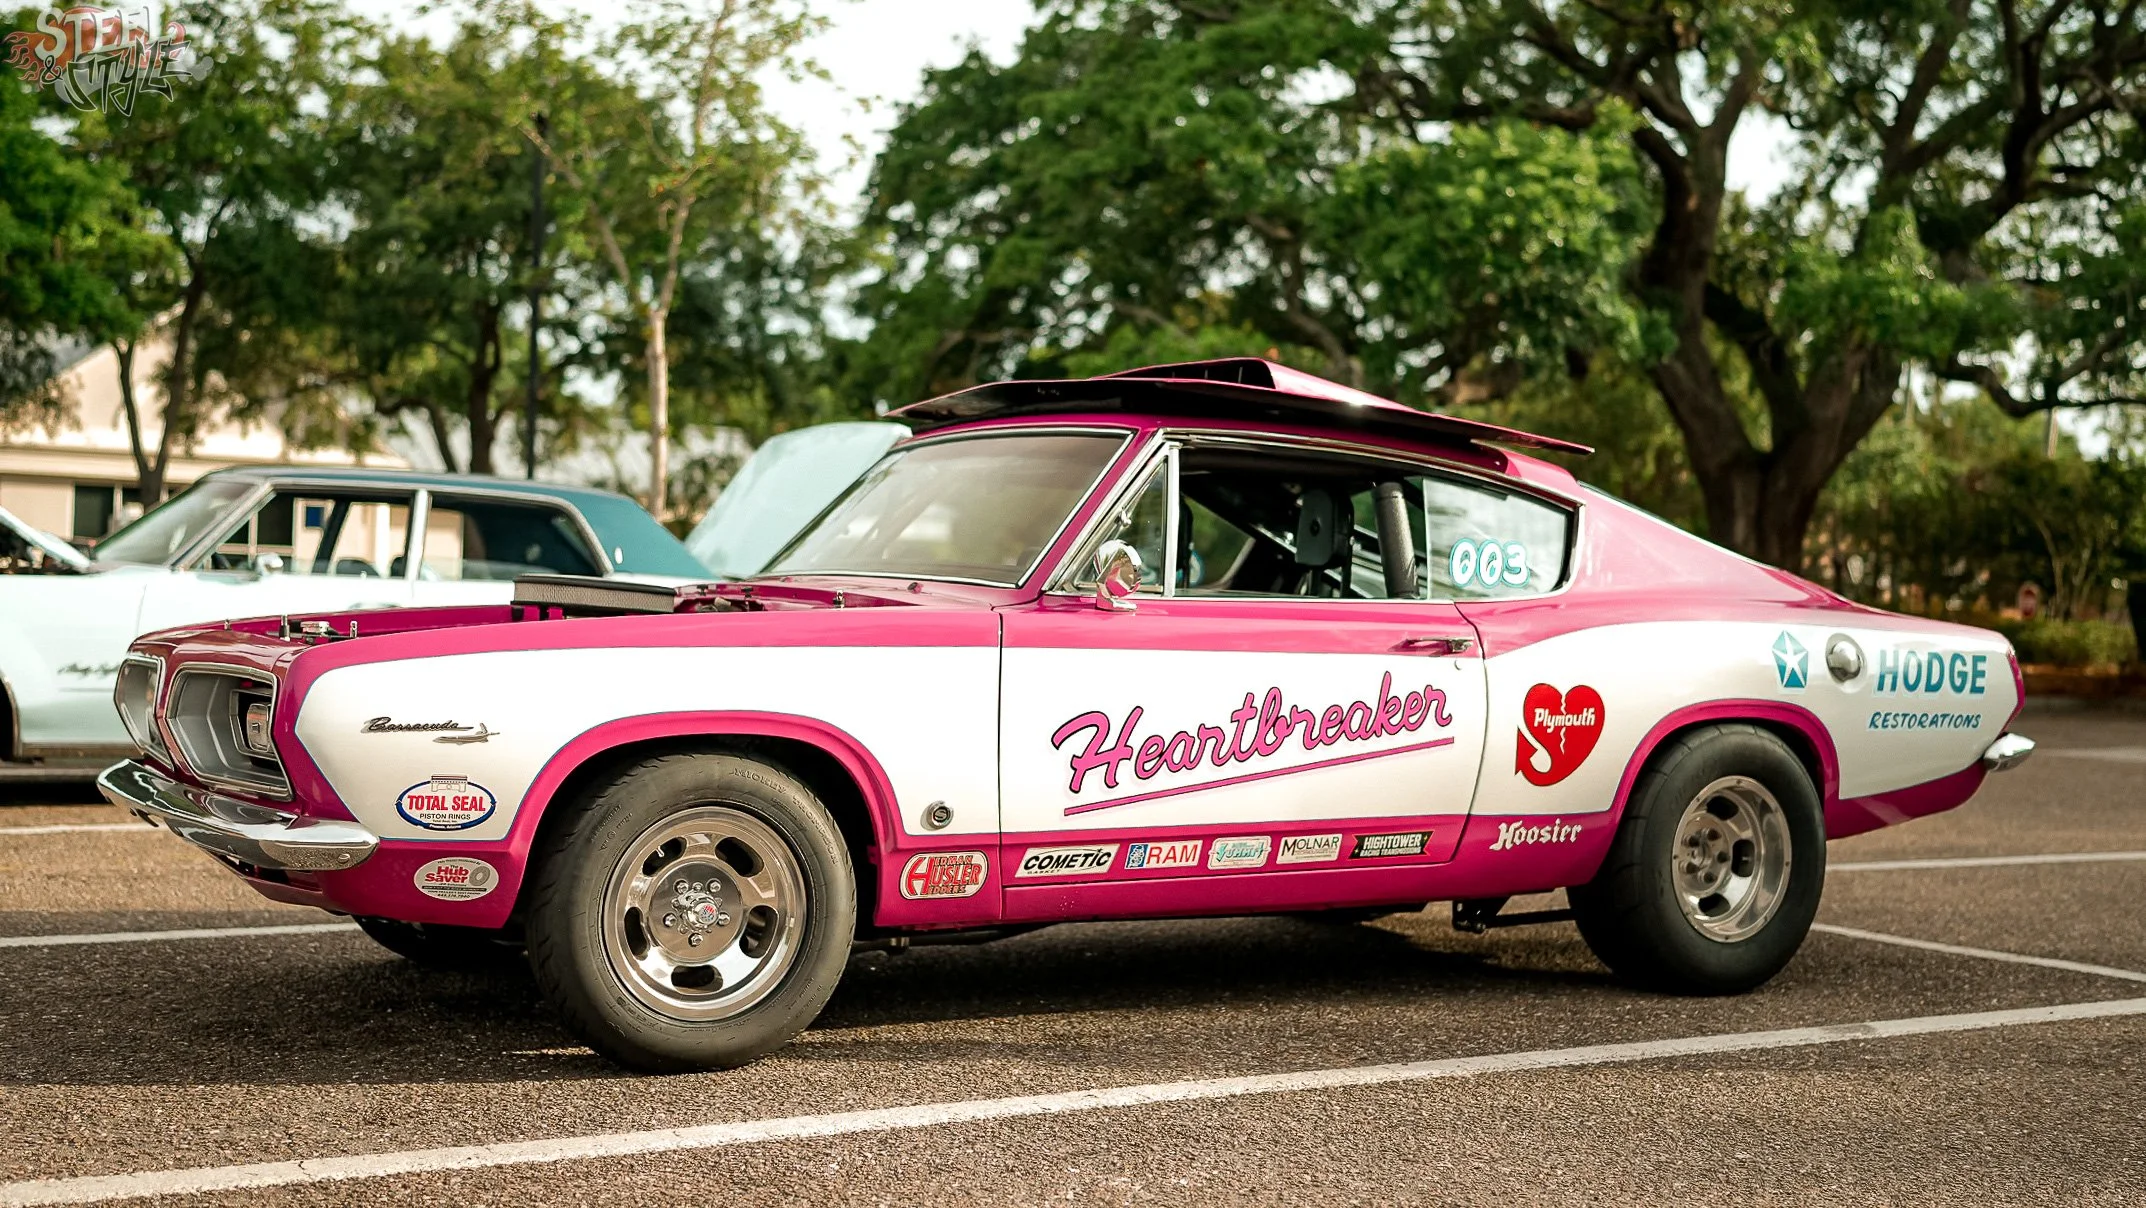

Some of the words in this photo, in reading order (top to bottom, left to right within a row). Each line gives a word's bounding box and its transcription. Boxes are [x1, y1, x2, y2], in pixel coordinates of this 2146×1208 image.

[1449, 537, 1531, 589] 003
[1876, 649, 1987, 694] HODGE
[367, 716, 474, 732] Barracuda
[1534, 707, 1596, 733] Plymouth
[1868, 711, 1982, 729] RESTORATIONS
[1051, 671, 1452, 793] Heartbreaker
[407, 794, 448, 811] TOTAL
[451, 795, 486, 812] SEAL
[419, 812, 447, 820] PISTON
[1363, 833, 1422, 850] HIGHTOWER
[1489, 818, 1582, 851] Hoosier
[1146, 843, 1198, 865] RAM
[1281, 836, 1340, 857] MOLNAR
[1023, 848, 1112, 871] COMETIC
[424, 872, 468, 883] Saver
[437, 865, 470, 876] Hub
